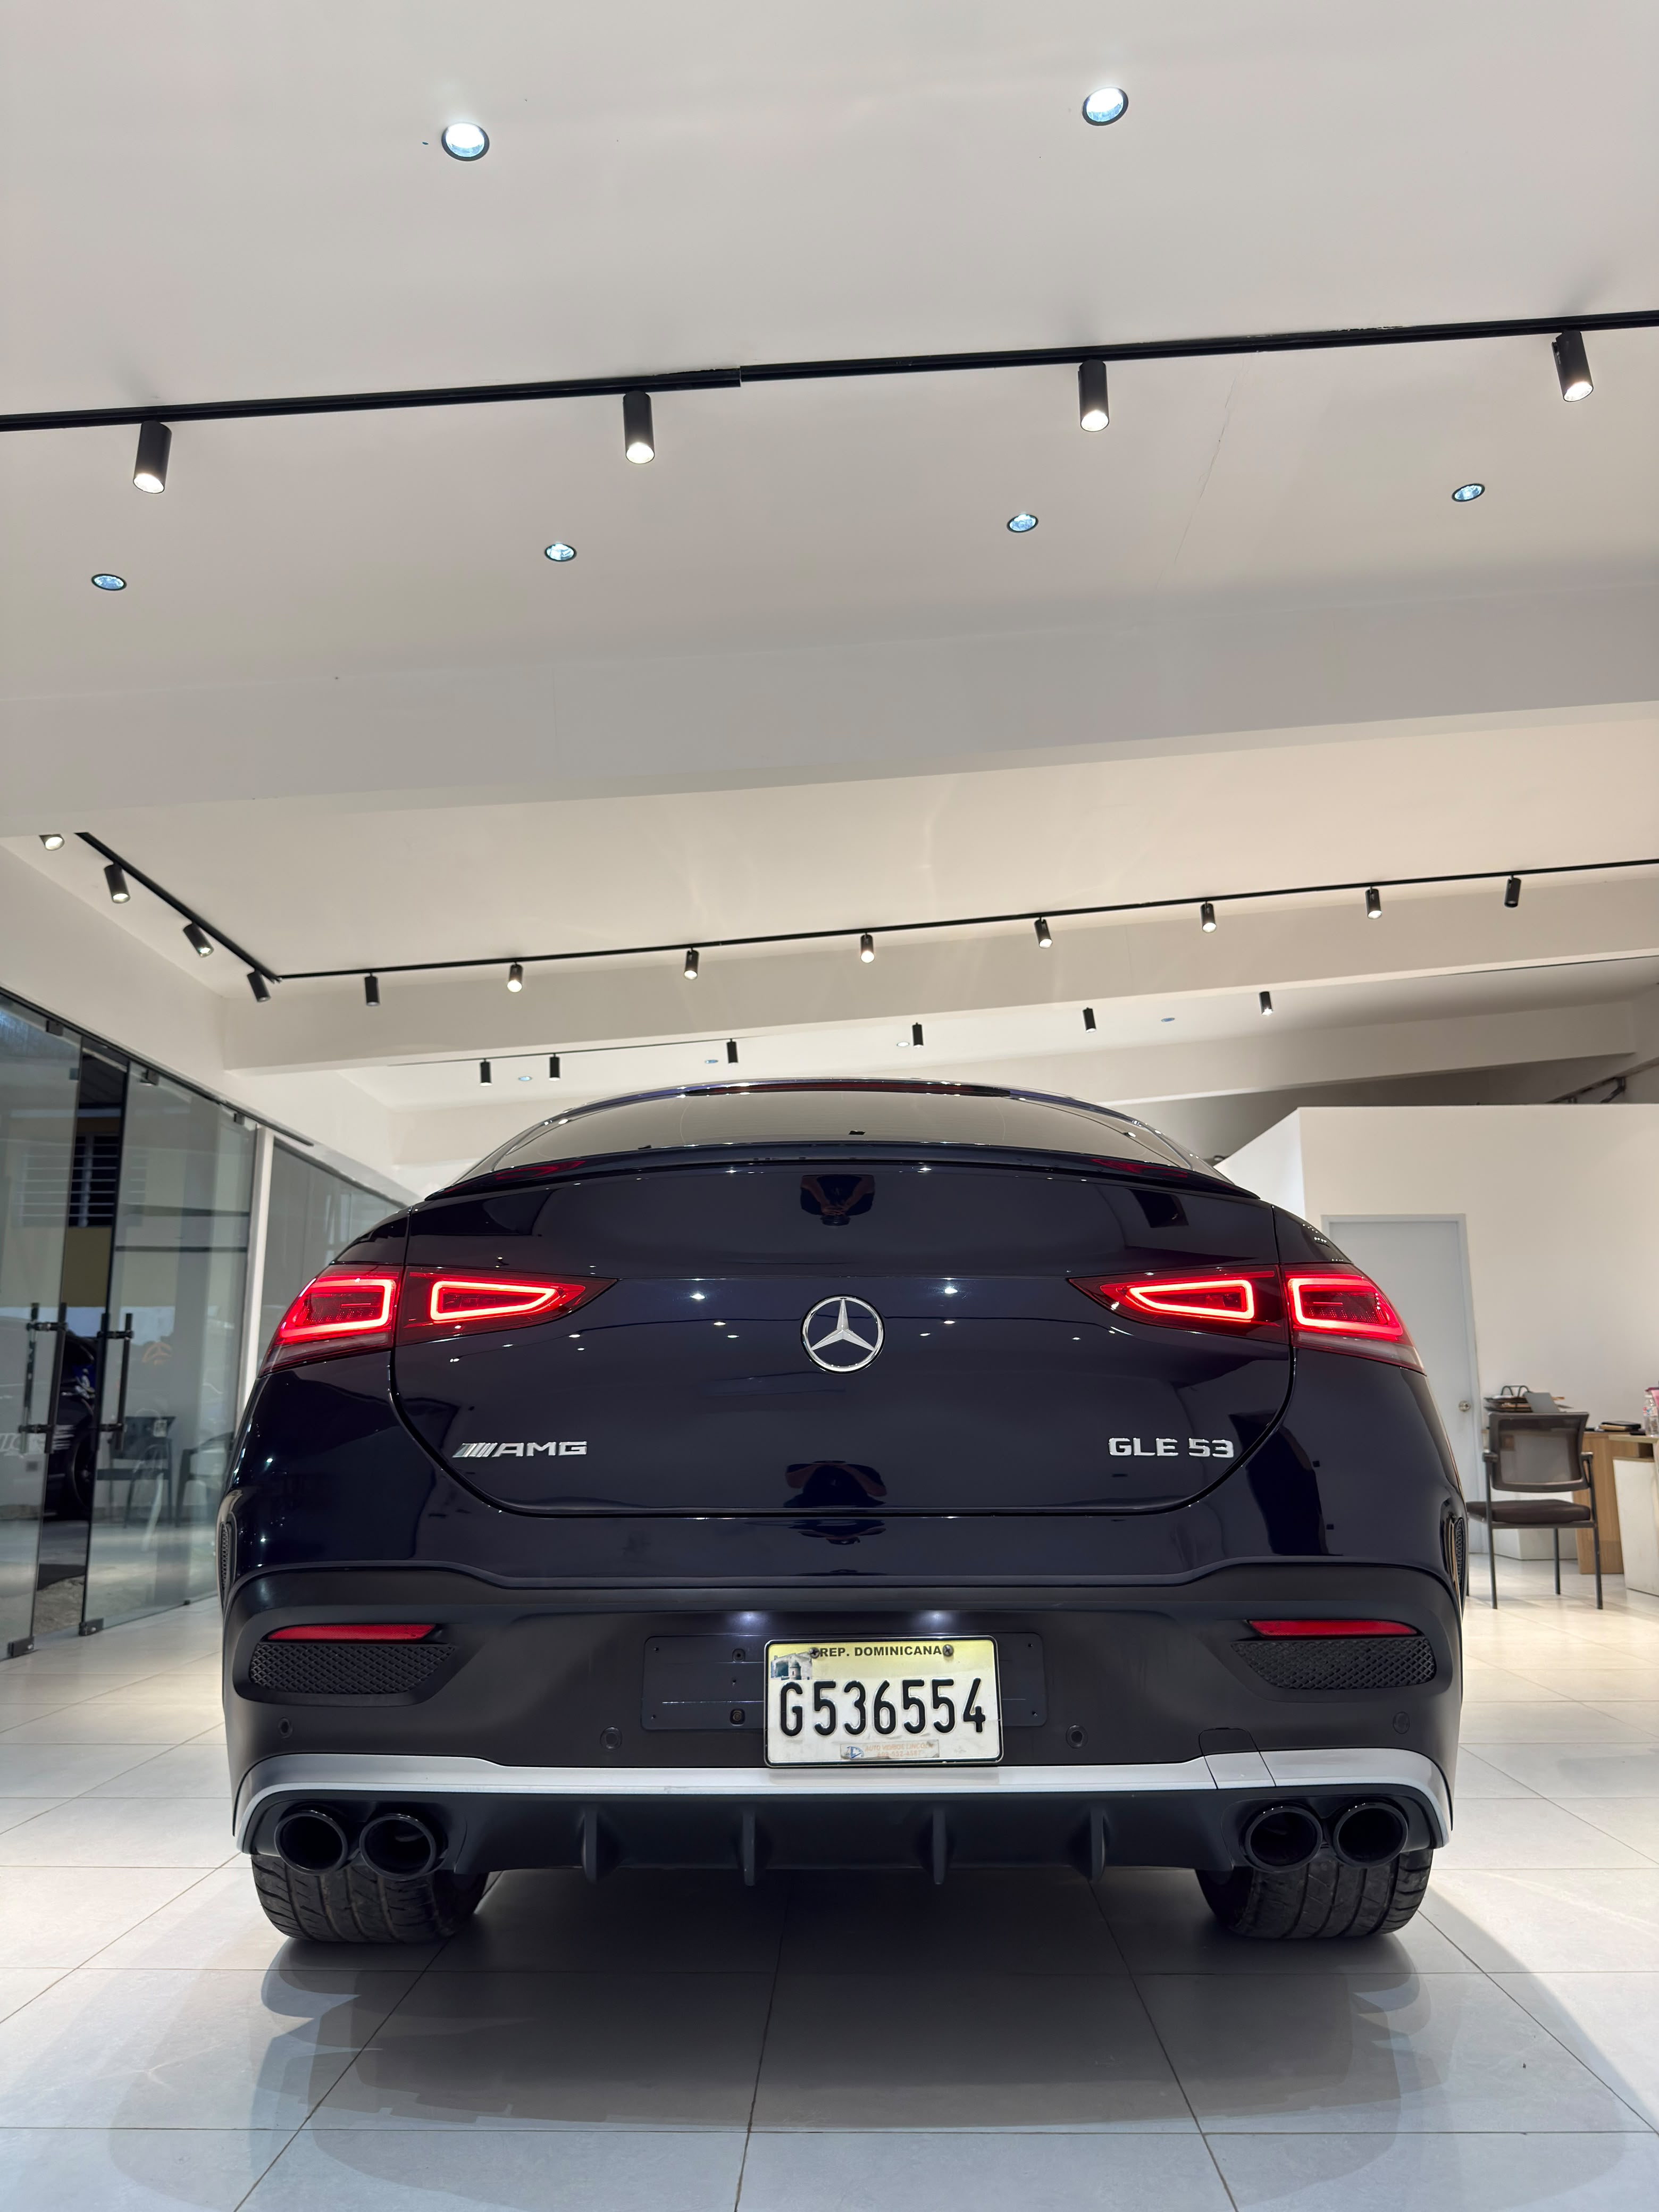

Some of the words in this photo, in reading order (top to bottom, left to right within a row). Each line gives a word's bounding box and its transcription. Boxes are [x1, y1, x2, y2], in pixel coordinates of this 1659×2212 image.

[491, 1440, 588, 1457] AMG
[1108, 1437, 1179, 1456] GLE
[1188, 1437, 1234, 1458] 53
[820, 1647, 850, 1657] REP.
[854, 1645, 942, 1656] DOMINICANA
[780, 1677, 986, 1737] G536554
